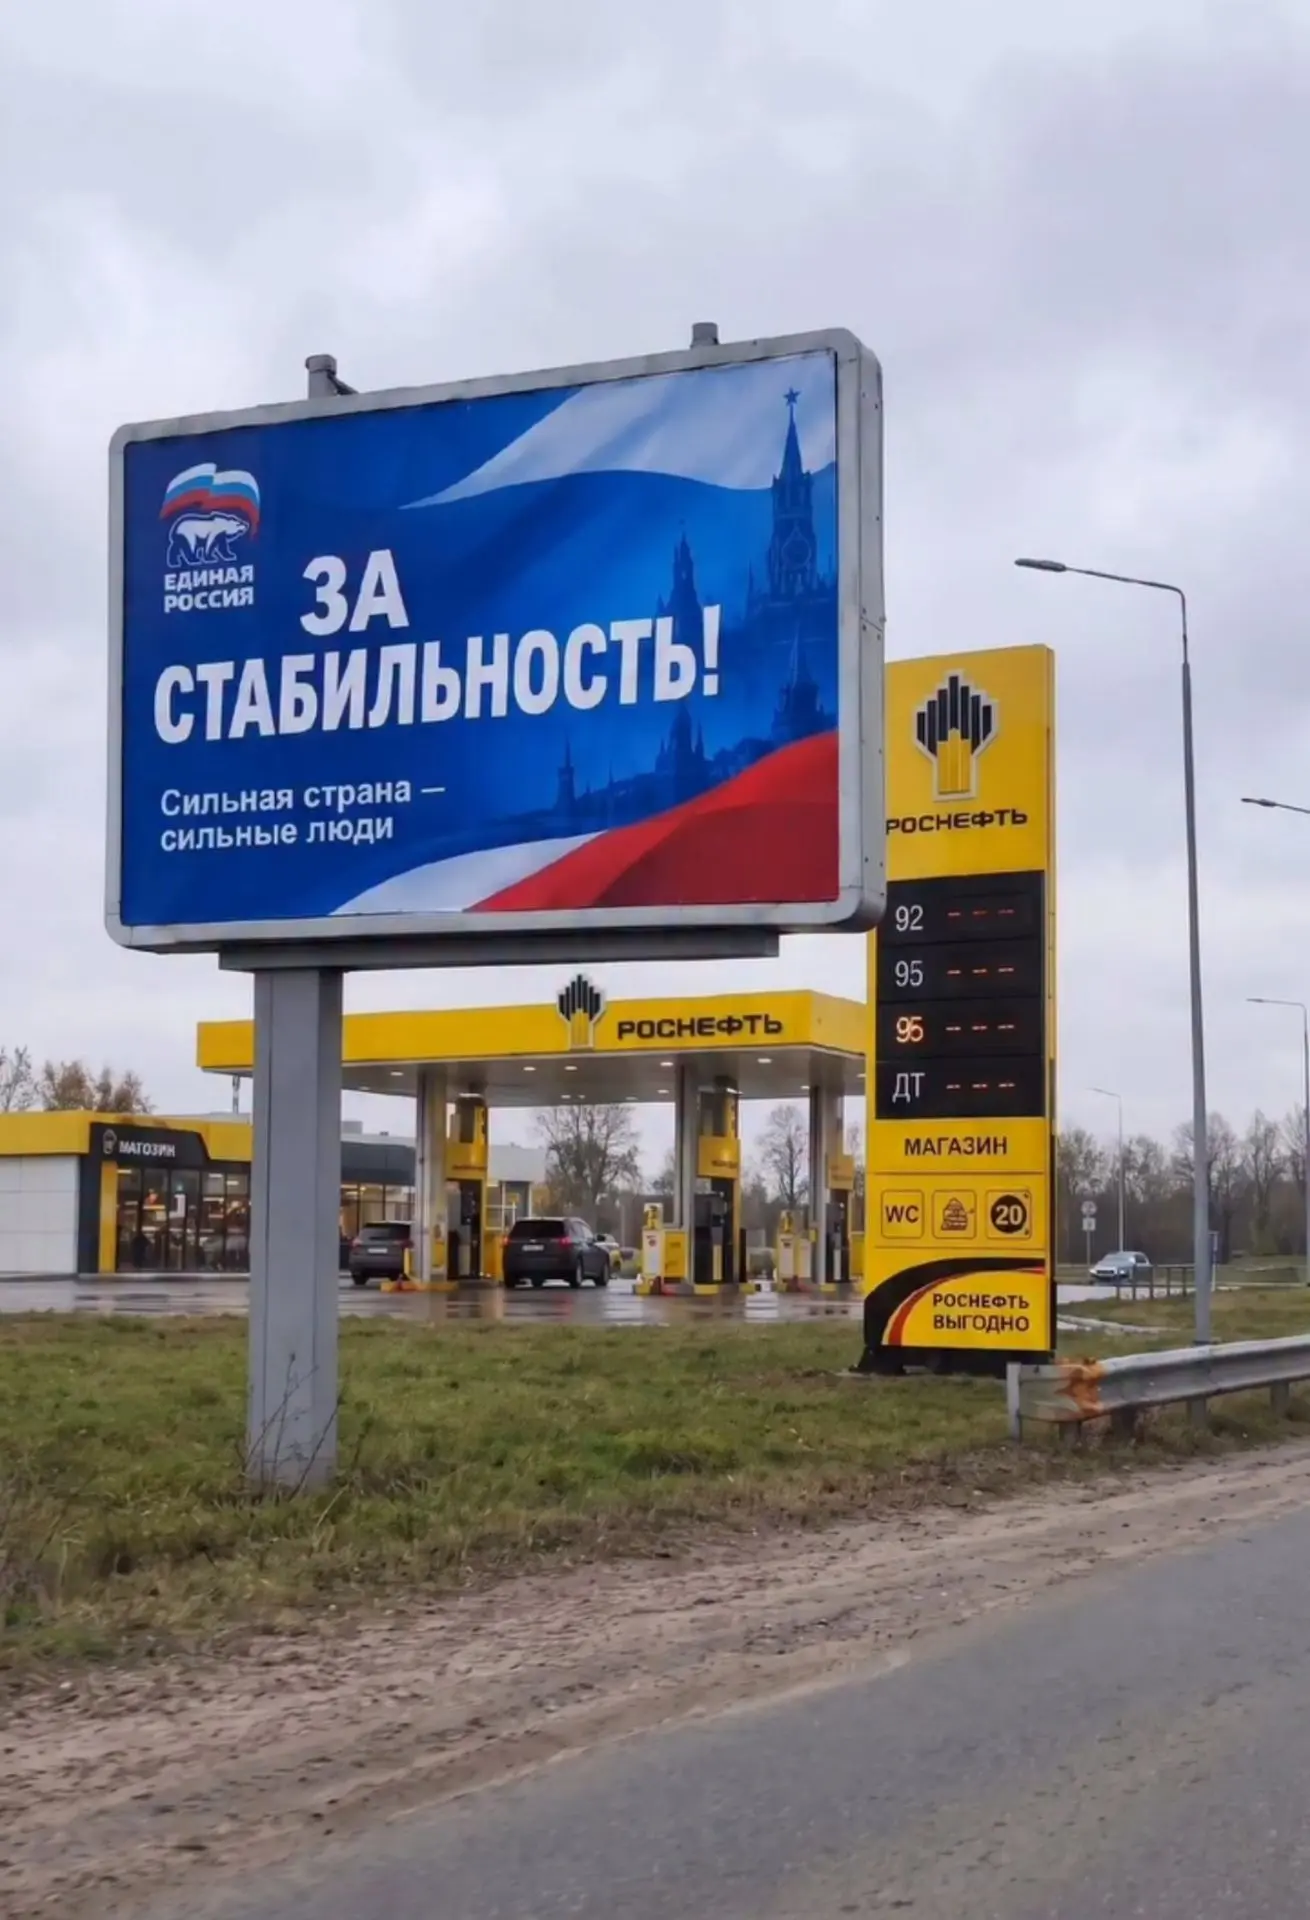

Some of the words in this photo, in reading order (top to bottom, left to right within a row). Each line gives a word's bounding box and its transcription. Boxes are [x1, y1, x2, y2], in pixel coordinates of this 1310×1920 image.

[163, 565, 254, 592] ЕДИНАЯ
[163, 587, 254, 613] РОССИЯ
[300, 549, 409, 636] ЗА
[153, 604, 722, 744] СТАБИЛЬНОСТЬ!
[160, 787, 294, 816] Сильная
[303, 780, 411, 813] страна
[160, 822, 298, 852] сильные
[306, 816, 394, 846] люди
[885, 808, 1028, 836] РОСНЕФТЬ
[895, 904, 924, 931] 92
[895, 960, 924, 987] 95
[617, 1013, 783, 1040] РОСНЕФТЬ
[896, 1016, 924, 1043] 95
[892, 1072, 925, 1103] ДТ
[904, 1136, 1008, 1156] МАГАЗИН
[885, 1205, 920, 1224] WC
[995, 1205, 1022, 1226] 20
[932, 1293, 1030, 1309] РОСНЕФТЬ
[932, 1315, 1030, 1333] ВЫГОДНО
